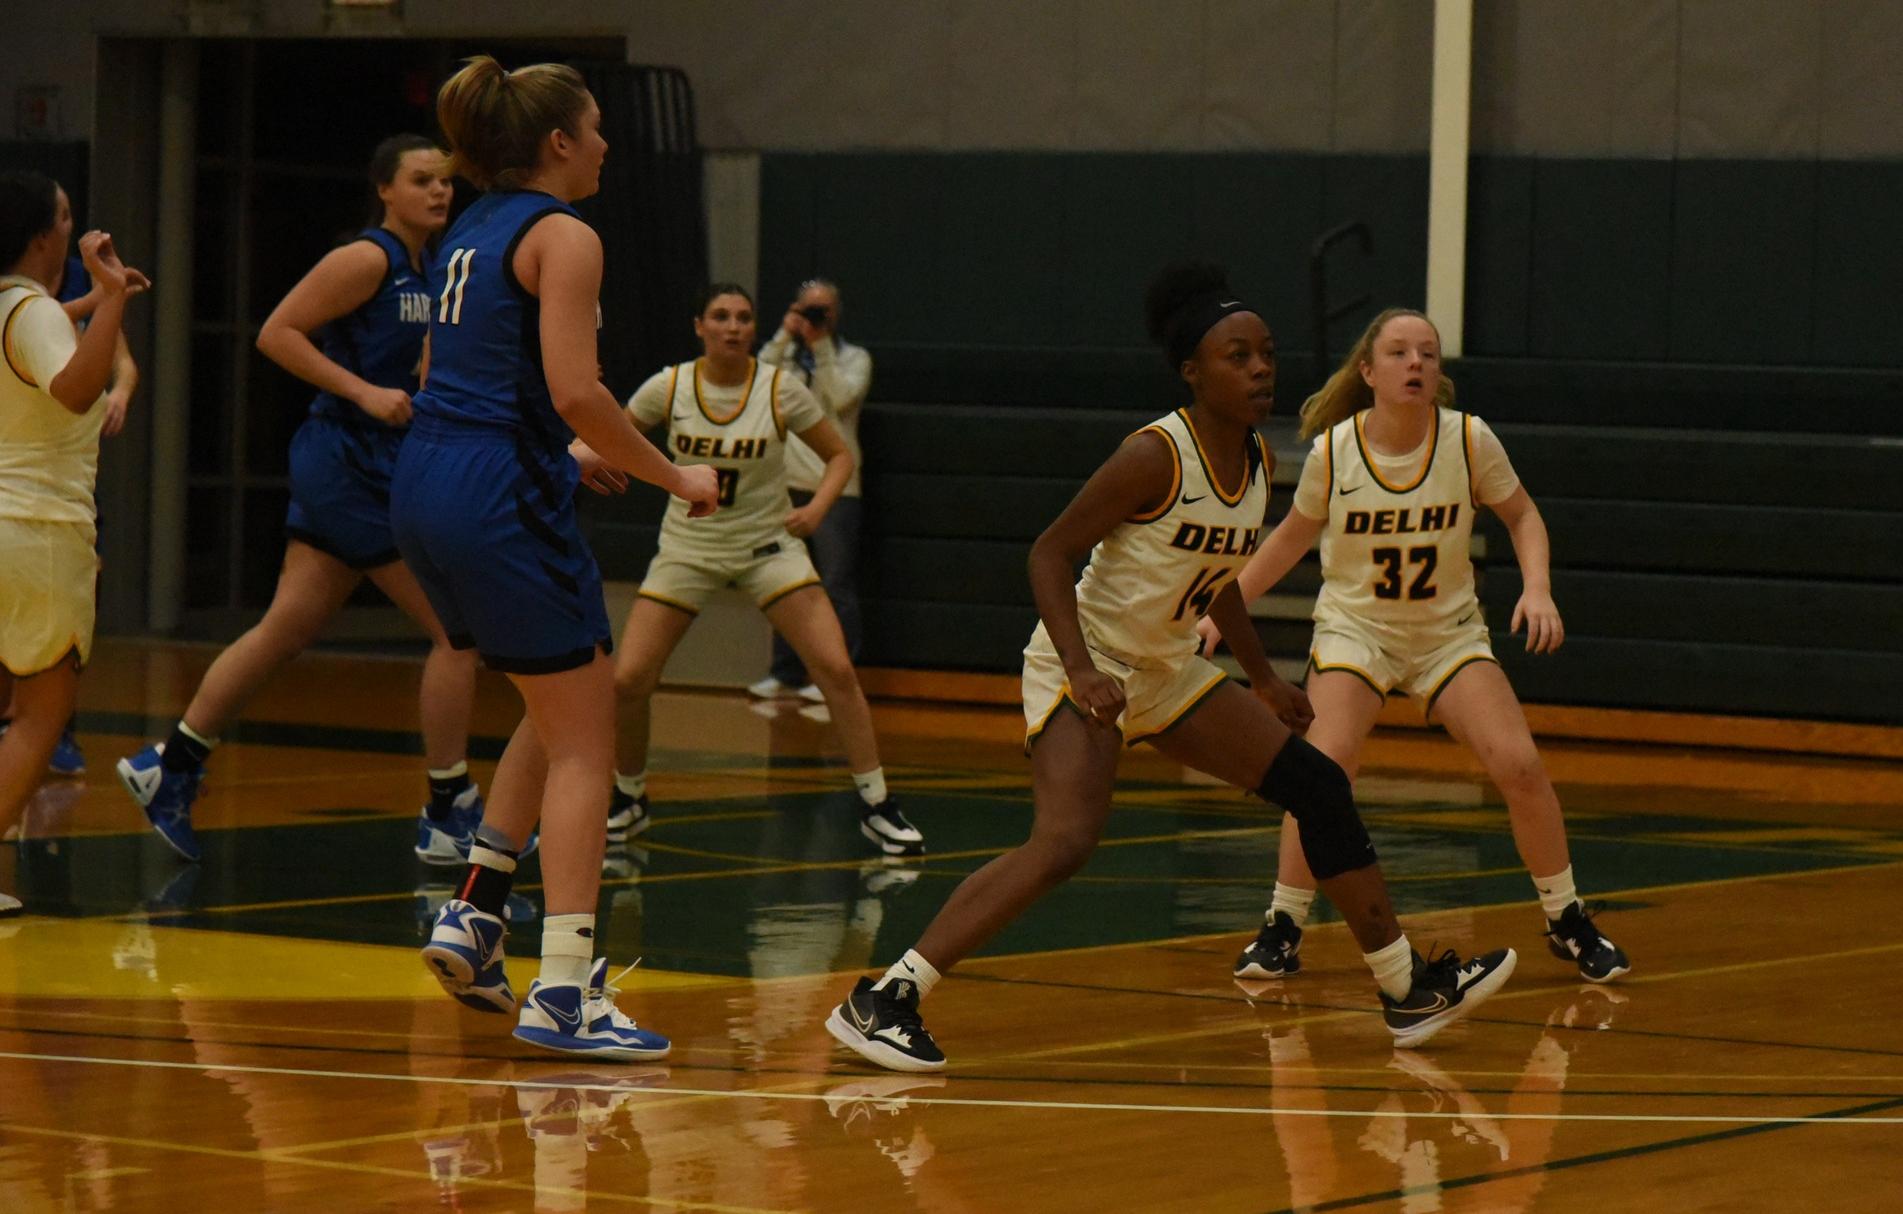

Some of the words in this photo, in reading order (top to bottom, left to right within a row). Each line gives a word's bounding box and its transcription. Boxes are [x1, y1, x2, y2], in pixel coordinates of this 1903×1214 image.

[438, 247, 477, 326] 11
[677, 435, 767, 459] DELHI
[1344, 503, 1459, 535] DELHI
[1170, 522, 1259, 556] DELH
[1373, 546, 1437, 600] 32
